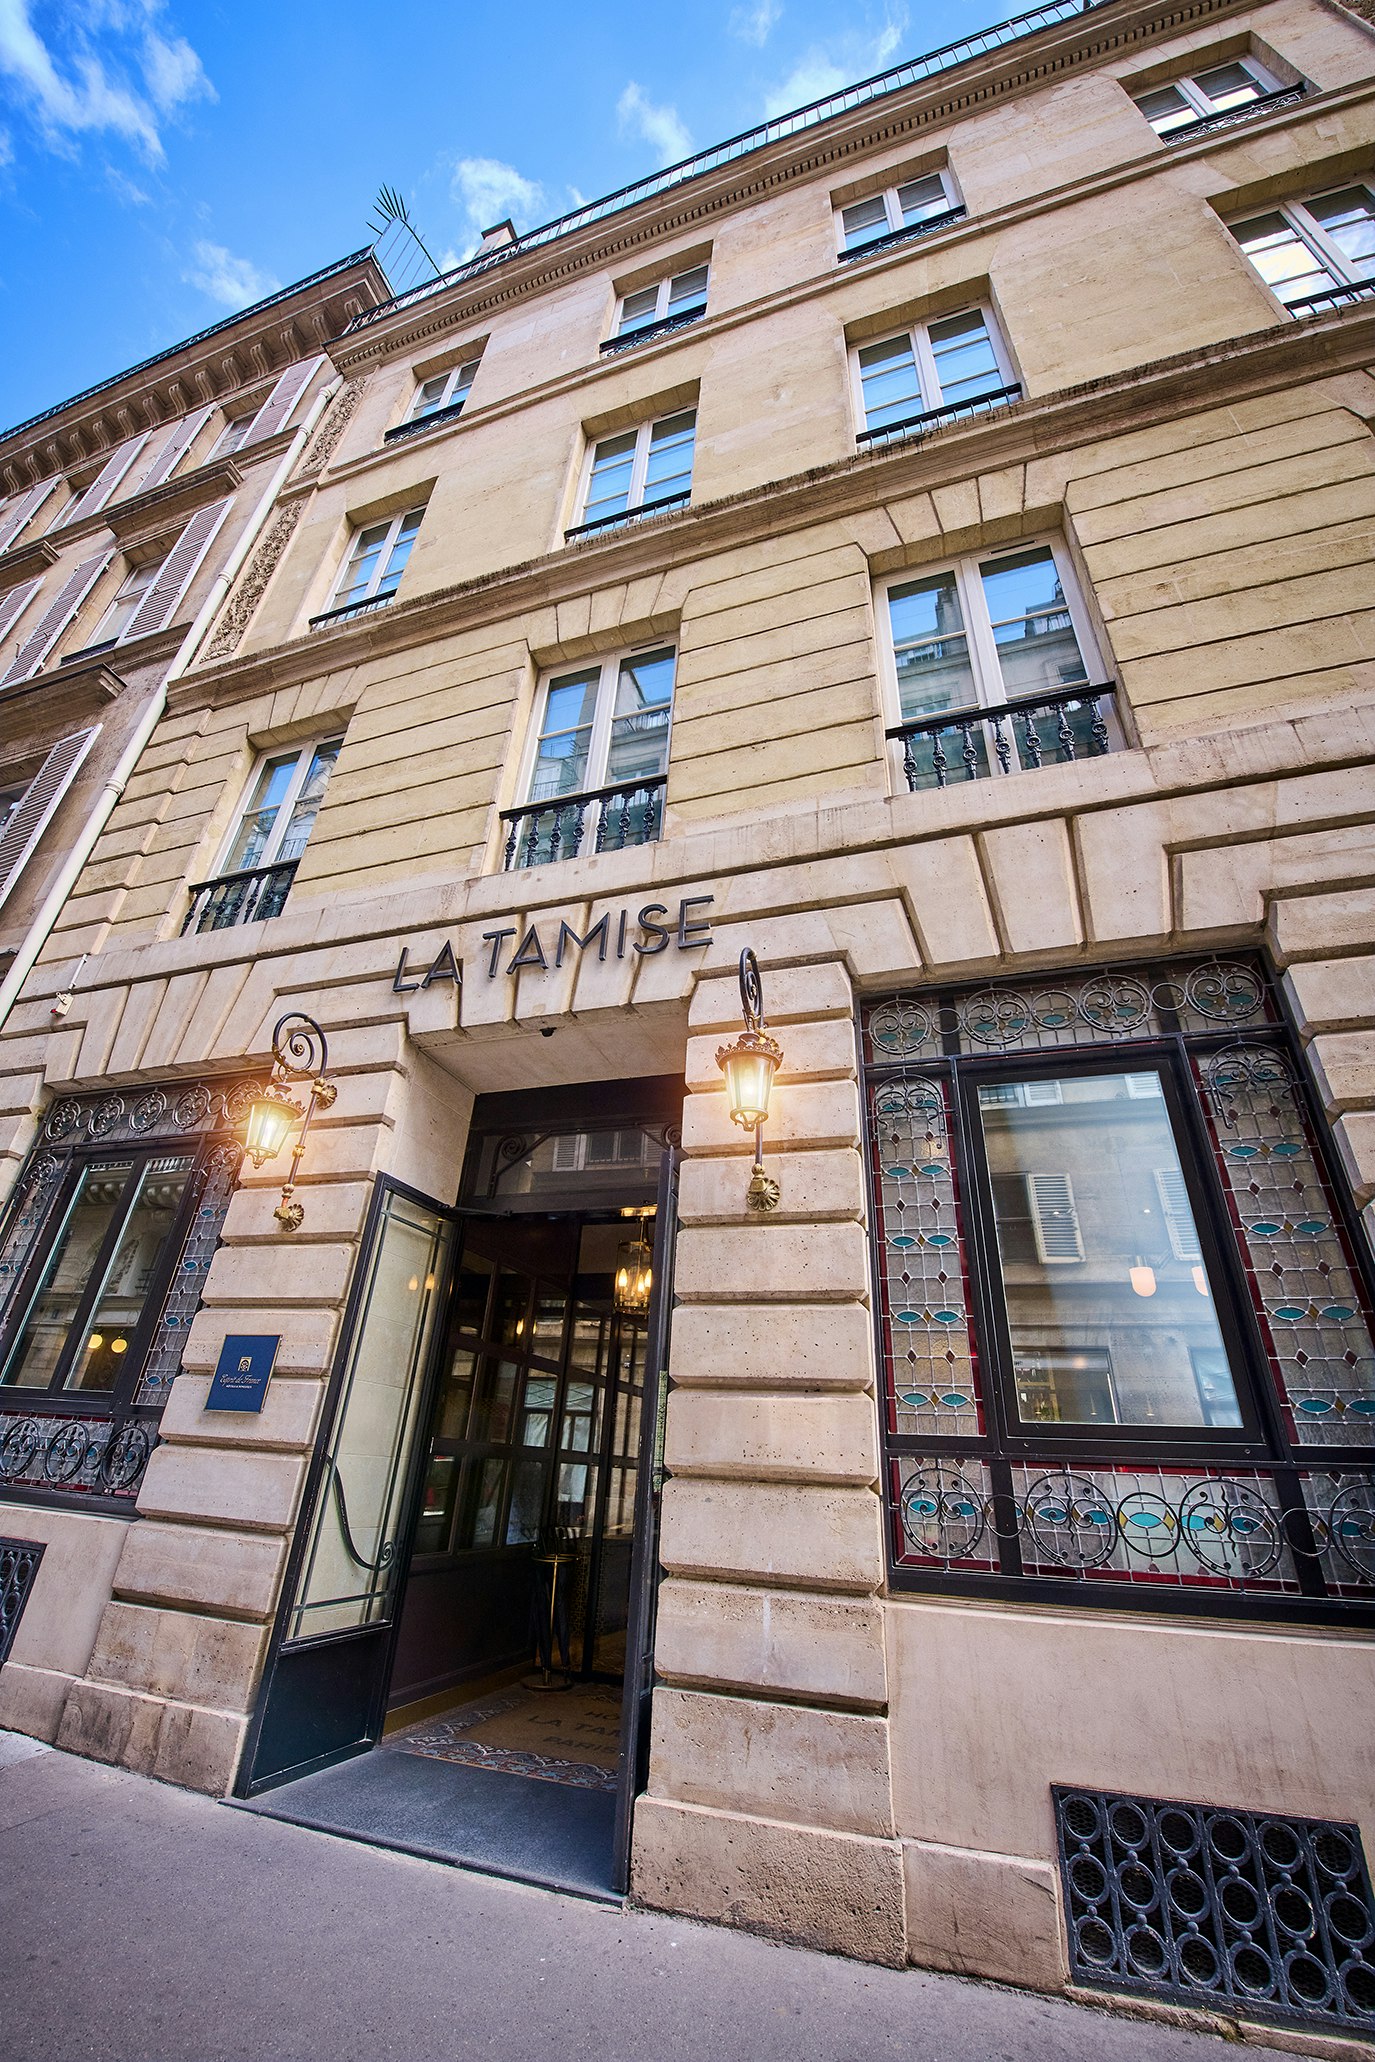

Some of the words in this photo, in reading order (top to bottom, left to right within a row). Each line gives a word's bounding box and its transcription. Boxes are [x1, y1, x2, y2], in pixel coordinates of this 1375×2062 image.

[392, 939, 463, 993] LA
[481, 894, 715, 978] TAMISE
[528, 1715, 562, 1727] LA
[542, 1736, 618, 1753] PARIS
